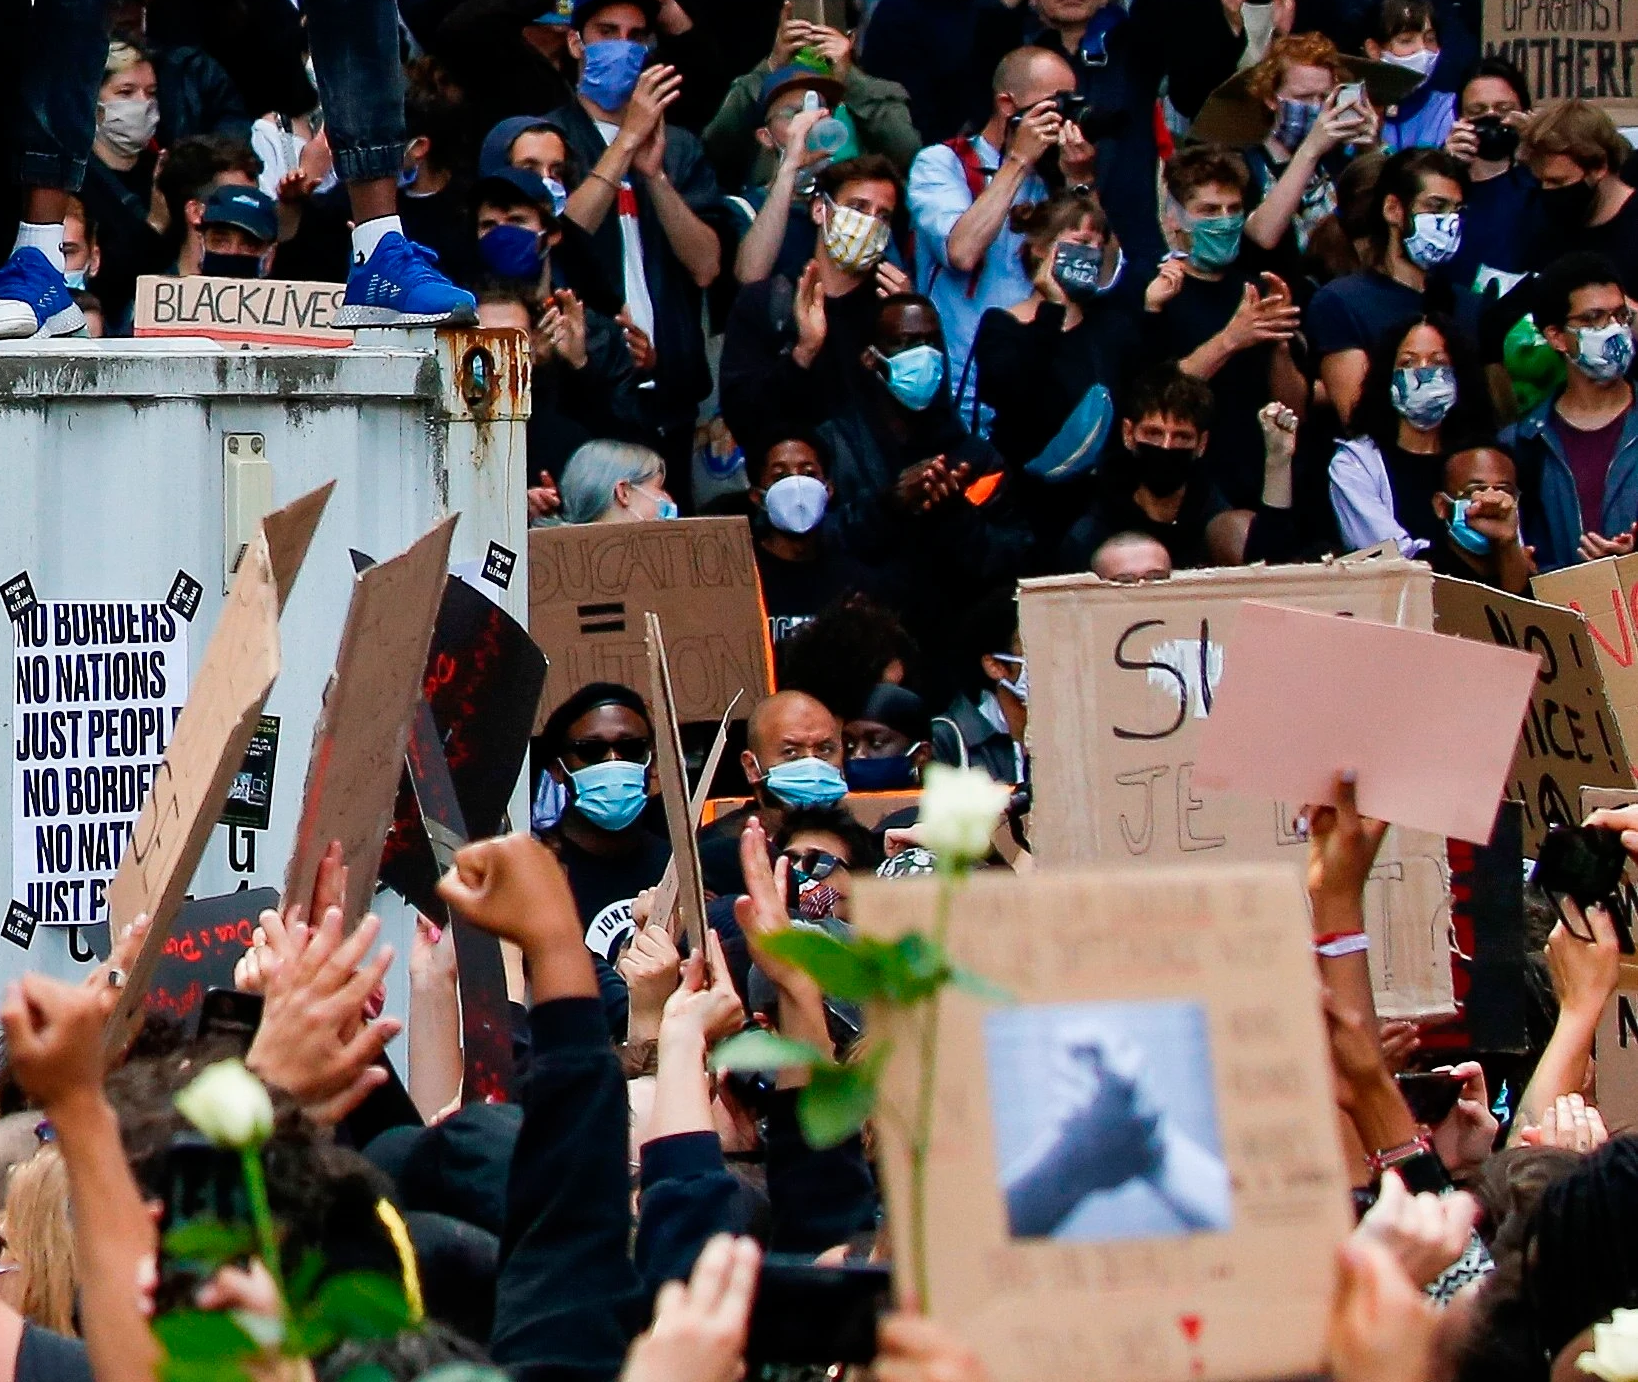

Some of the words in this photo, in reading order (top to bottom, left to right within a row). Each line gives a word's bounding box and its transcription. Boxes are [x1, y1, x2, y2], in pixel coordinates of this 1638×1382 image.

[154, 282, 262, 325] BLACK
[17, 604, 48, 648] NO
[54, 603, 176, 647] BORDERS
[17, 654, 50, 704] NO
[55, 651, 167, 703] NATIONS
[16, 710, 82, 761] JUST
[23, 769, 59, 818] NO
[66, 764, 161, 816] BORDE
[1116, 762, 1227, 856] JE
[36, 823, 77, 874] NO
